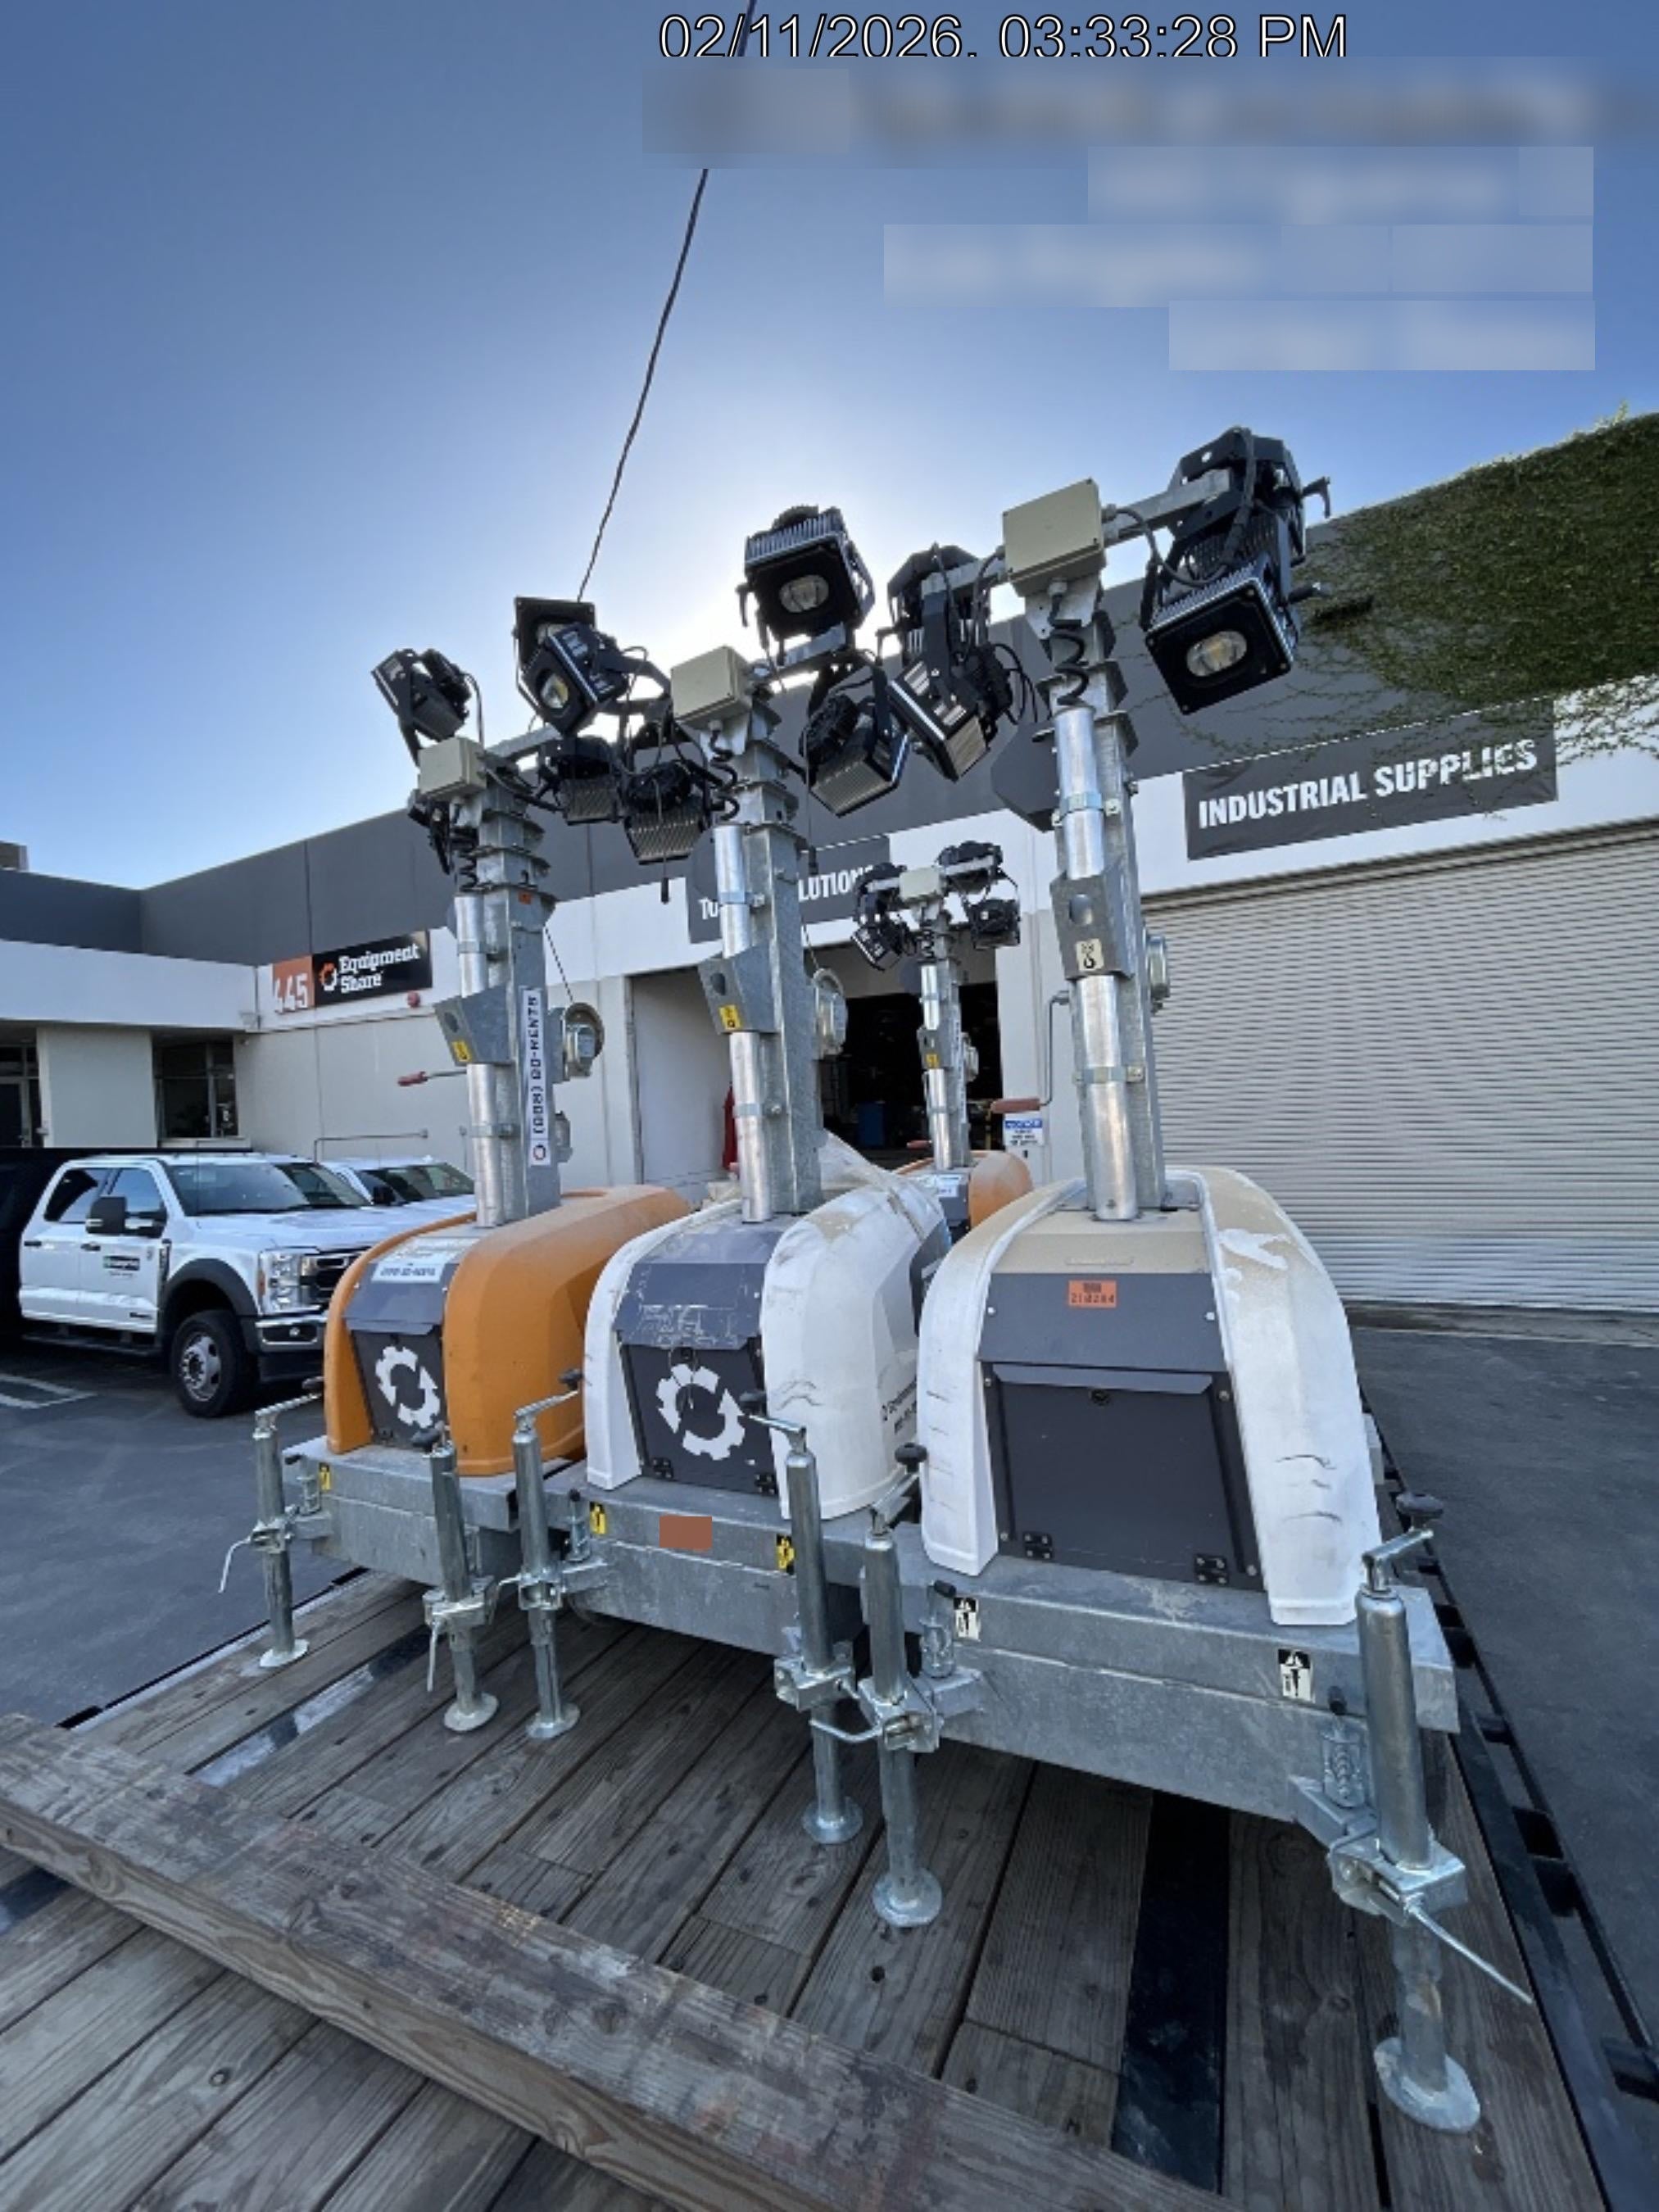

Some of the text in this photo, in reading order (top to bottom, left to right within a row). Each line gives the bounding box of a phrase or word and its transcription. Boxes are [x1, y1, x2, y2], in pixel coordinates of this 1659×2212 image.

[1199, 738, 1539, 830] INDUSTRIAL SUPPLIES
[338, 943, 421, 973] Equipment
[340, 971, 382, 994] Share
